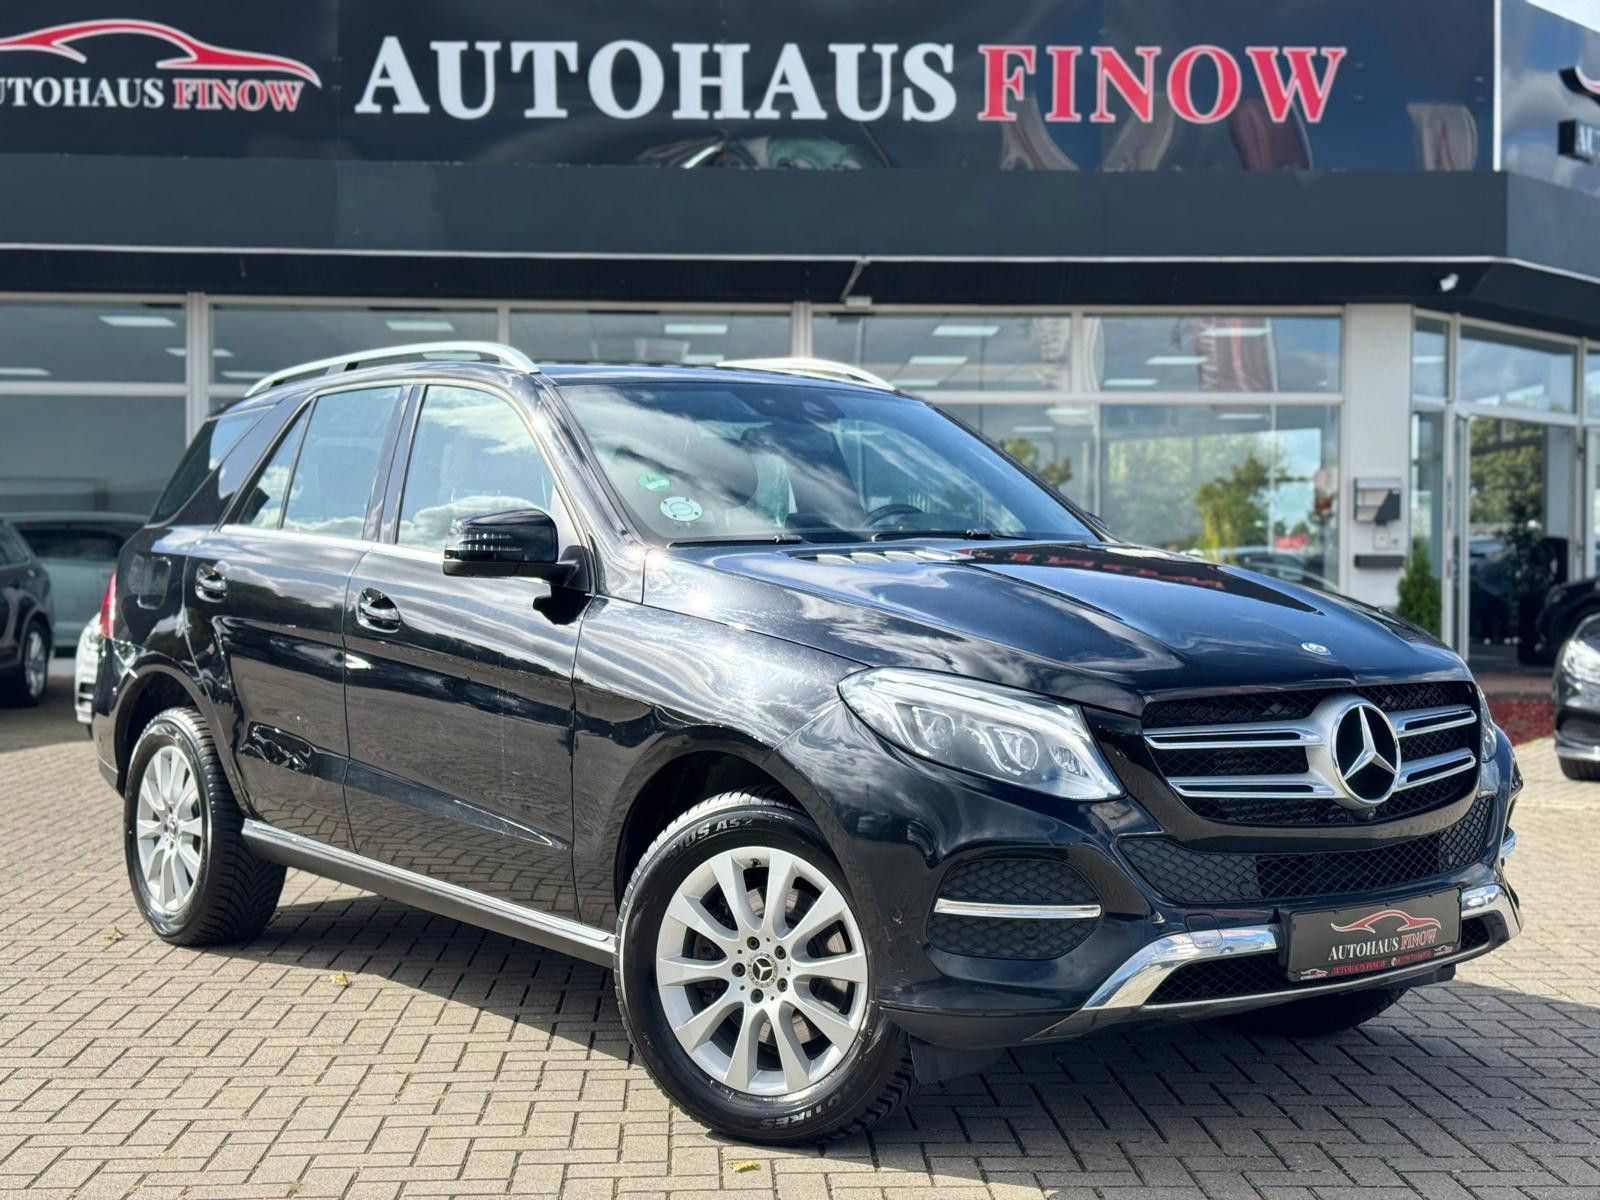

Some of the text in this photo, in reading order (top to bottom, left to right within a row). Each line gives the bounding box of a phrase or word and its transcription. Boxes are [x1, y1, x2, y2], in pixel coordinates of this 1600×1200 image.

[173, 78, 304, 111] FINOW
[355, 36, 1347, 123] AUTOHAUS FINOW
[1328, 937, 1399, 961] AUTOHAUS
[1400, 928, 1437, 950] FINOW
